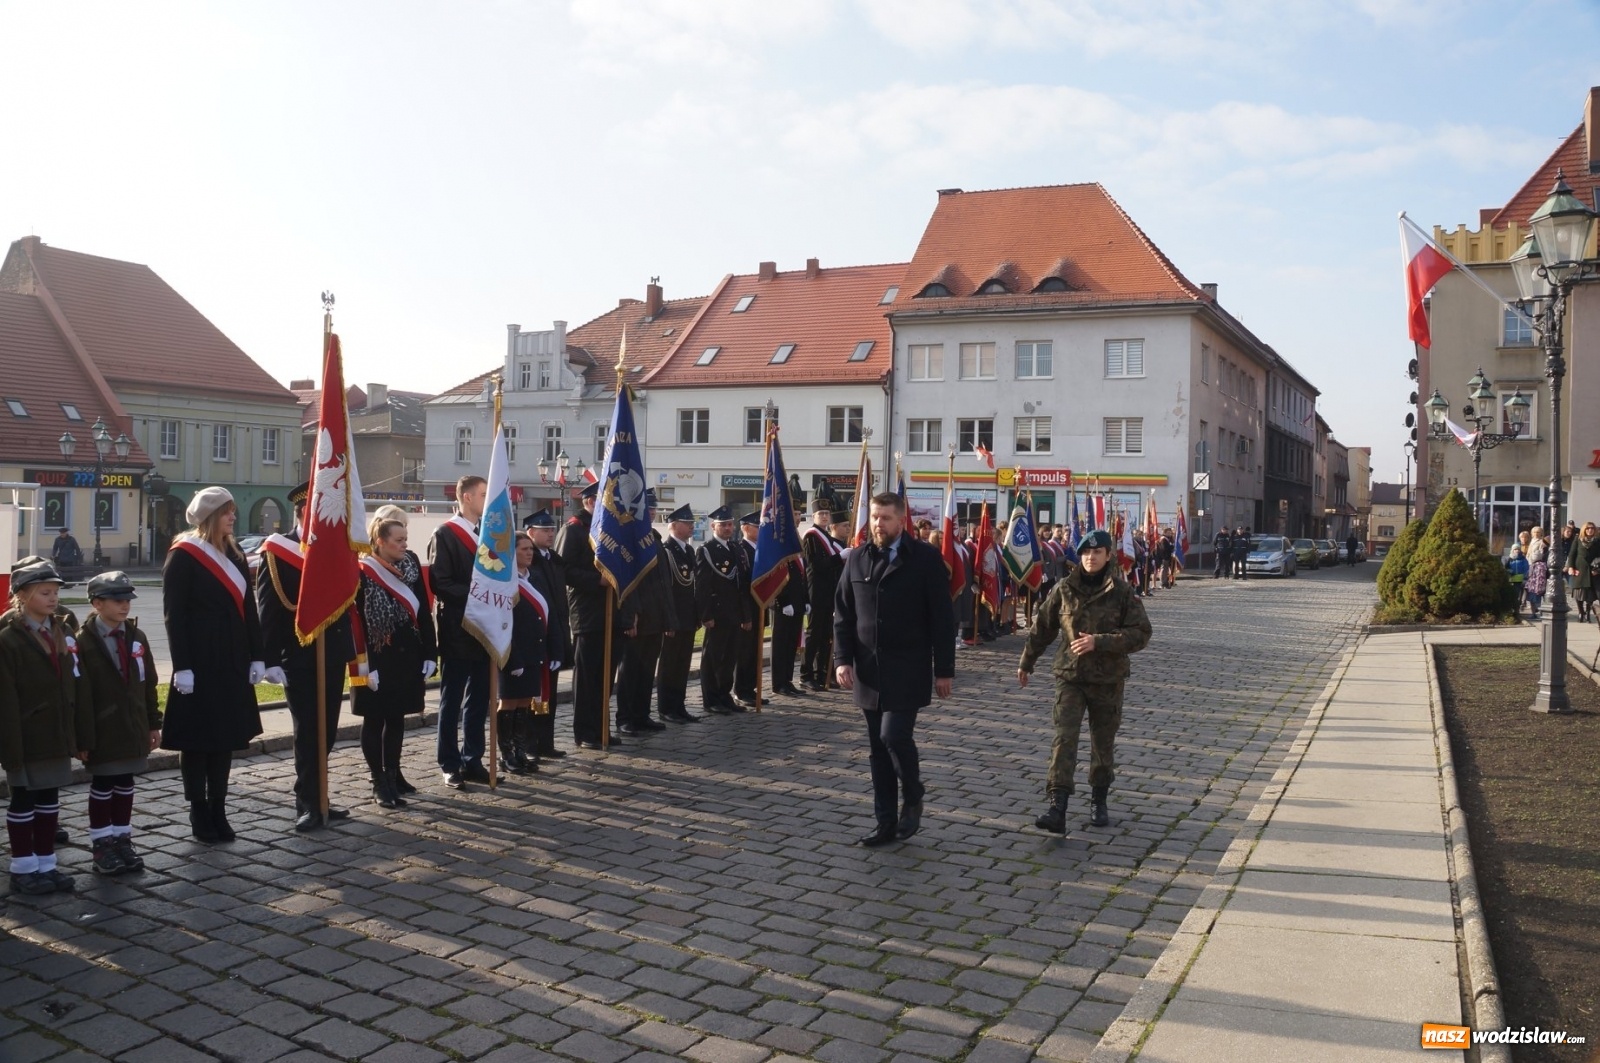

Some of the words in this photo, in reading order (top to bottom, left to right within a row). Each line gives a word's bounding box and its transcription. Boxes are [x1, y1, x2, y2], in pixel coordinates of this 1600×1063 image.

[35, 472, 67, 484] QUIZ
[102, 475, 132, 486] OPEN
[1025, 471, 1067, 484] Impuls
[1447, 477, 1458, 485] 13
